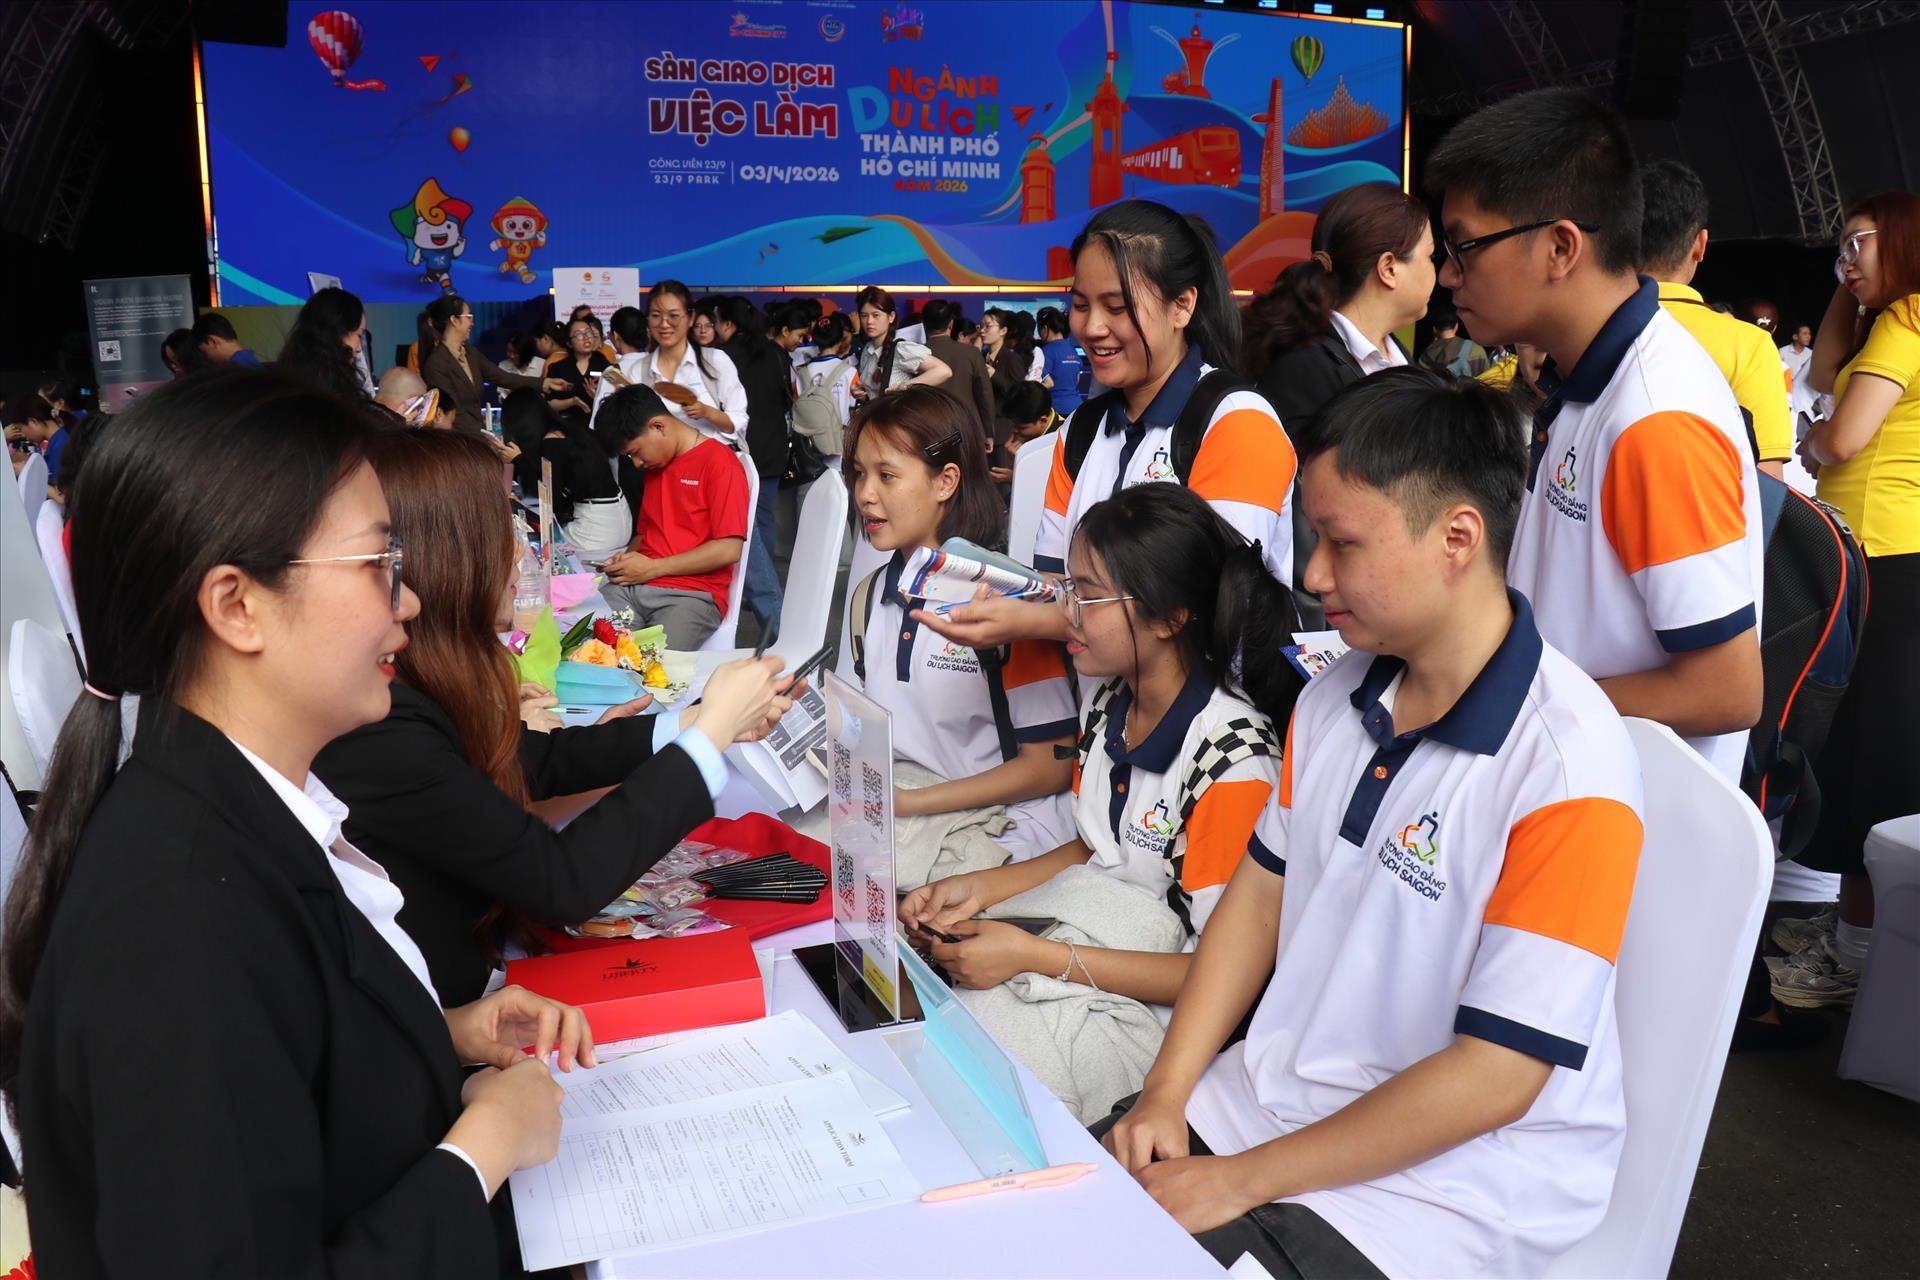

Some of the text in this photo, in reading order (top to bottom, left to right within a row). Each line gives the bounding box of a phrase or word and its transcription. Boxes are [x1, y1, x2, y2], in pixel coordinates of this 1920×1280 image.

[645, 51, 834, 93] SÀN GIAO DỊCH
[888, 64, 998, 102] NGÀNH
[649, 88, 839, 147] VIỆC LÀM
[847, 85, 999, 135] DU LỊCH
[860, 130, 1000, 157] THÀNH PHỐ
[648, 157, 726, 170] CÔNG VIÊN 23/9
[739, 164, 839, 184] 03/4/2026
[860, 152, 1000, 179] HỒ CHÍ MINH
[654, 174, 719, 185] 23/9 PARK
[935, 180, 968, 192] 2026
[927, 660, 937, 668] DU
[951, 663, 978, 674] SAIGON
[1403, 857, 1421, 874] CAO
[1399, 868, 1442, 901] SAIGON
